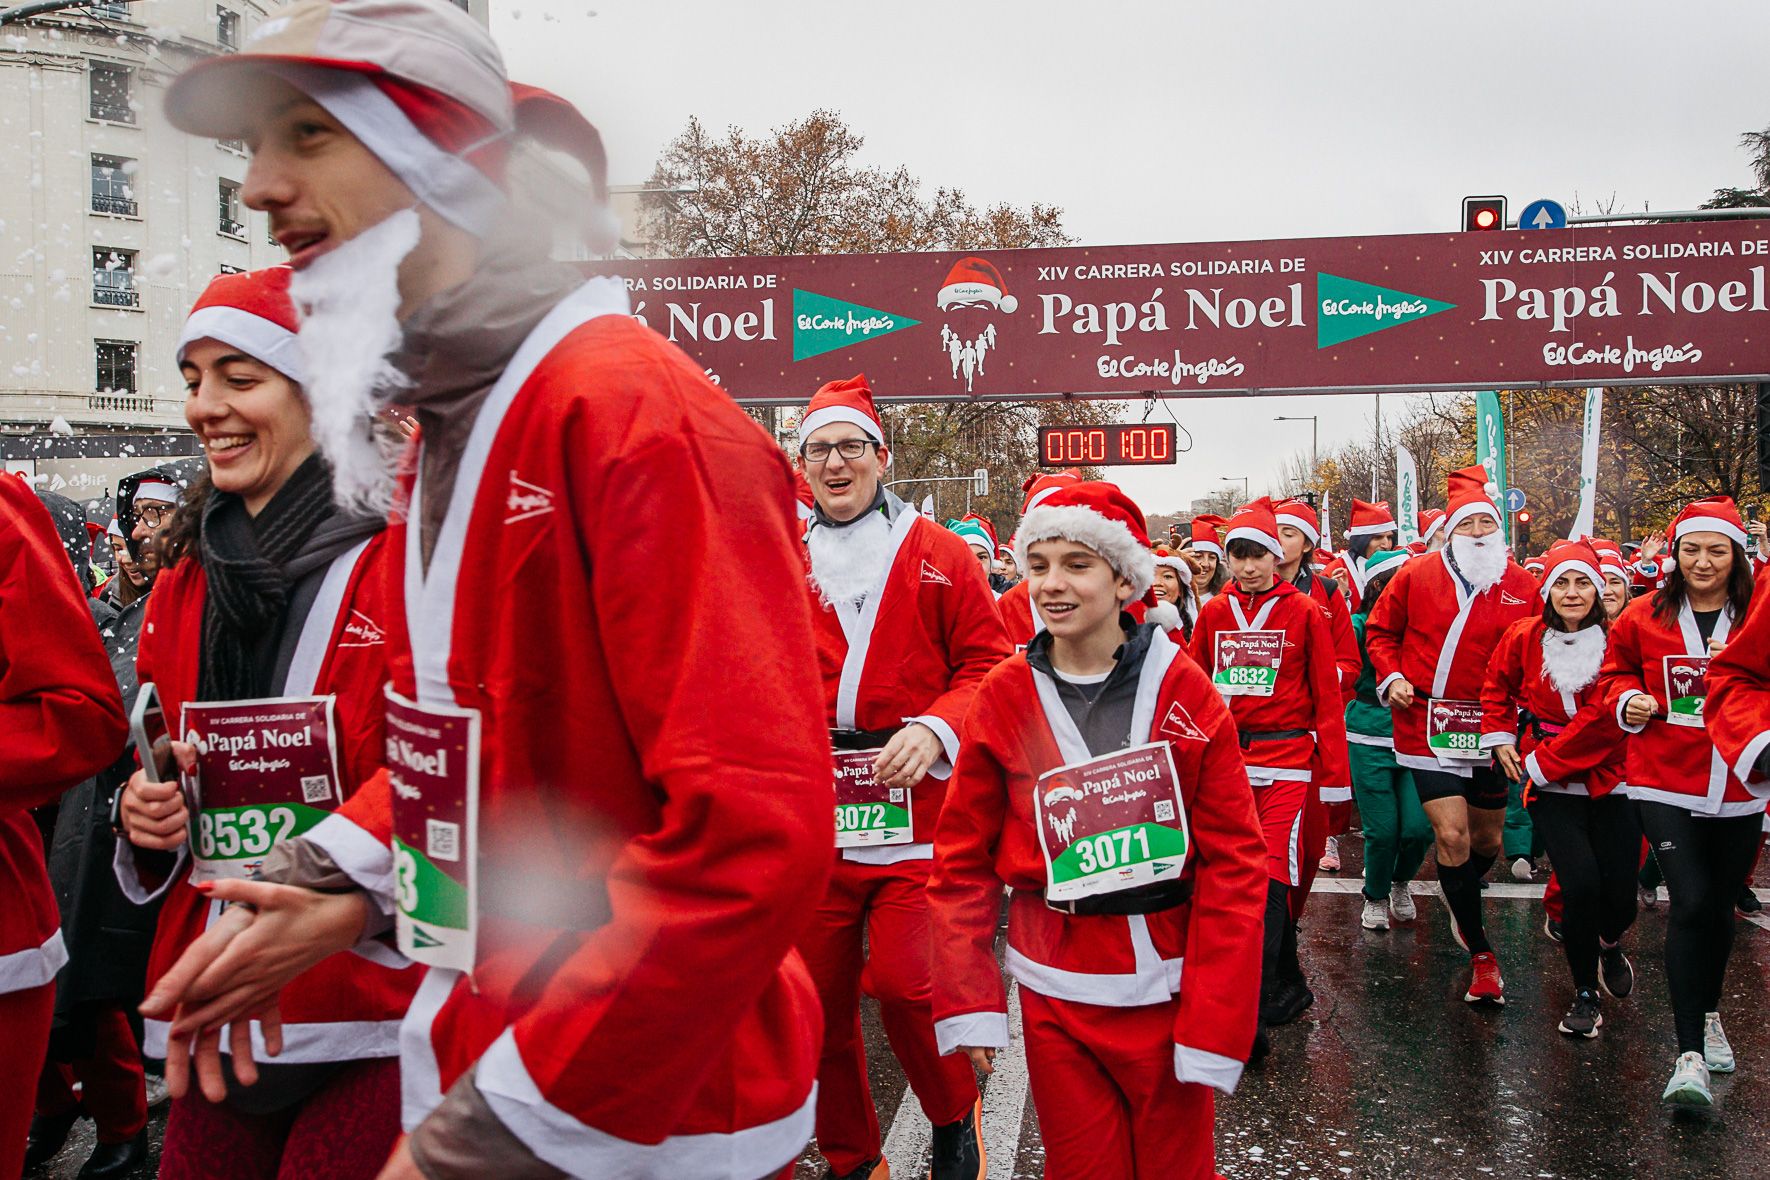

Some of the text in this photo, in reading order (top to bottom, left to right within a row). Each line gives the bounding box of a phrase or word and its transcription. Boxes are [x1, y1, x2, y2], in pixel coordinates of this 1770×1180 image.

[1479, 240, 1769, 266] XIV CARRERA SOLIDARIA DE
[652, 276, 748, 291] SOLIDARIA
[753, 274, 777, 288] DE
[1037, 258, 1306, 282] XIV CARRERA SOLIDARIA DE
[1322, 294, 1428, 321] El Corte Inglés
[1478, 265, 1770, 333] Papá Noel
[665, 298, 778, 343] Noel
[797, 310, 894, 336] El Corte Inglés
[1037, 283, 1306, 346] Papá Noel
[1097, 350, 1246, 386] El Corte Inglés
[1542, 335, 1702, 373] El Corte Inglés
[1240, 640, 1259, 650] Papá
[1230, 668, 1268, 684] 6832
[208, 725, 312, 756] Papá Noel
[1448, 734, 1476, 748] 388
[399, 740, 448, 777] Noel
[843, 764, 868, 778] Papá
[1082, 764, 1160, 796] Papá Noel
[834, 804, 886, 830] 3072
[198, 807, 296, 858] 8532
[1076, 827, 1150, 874] 3071
